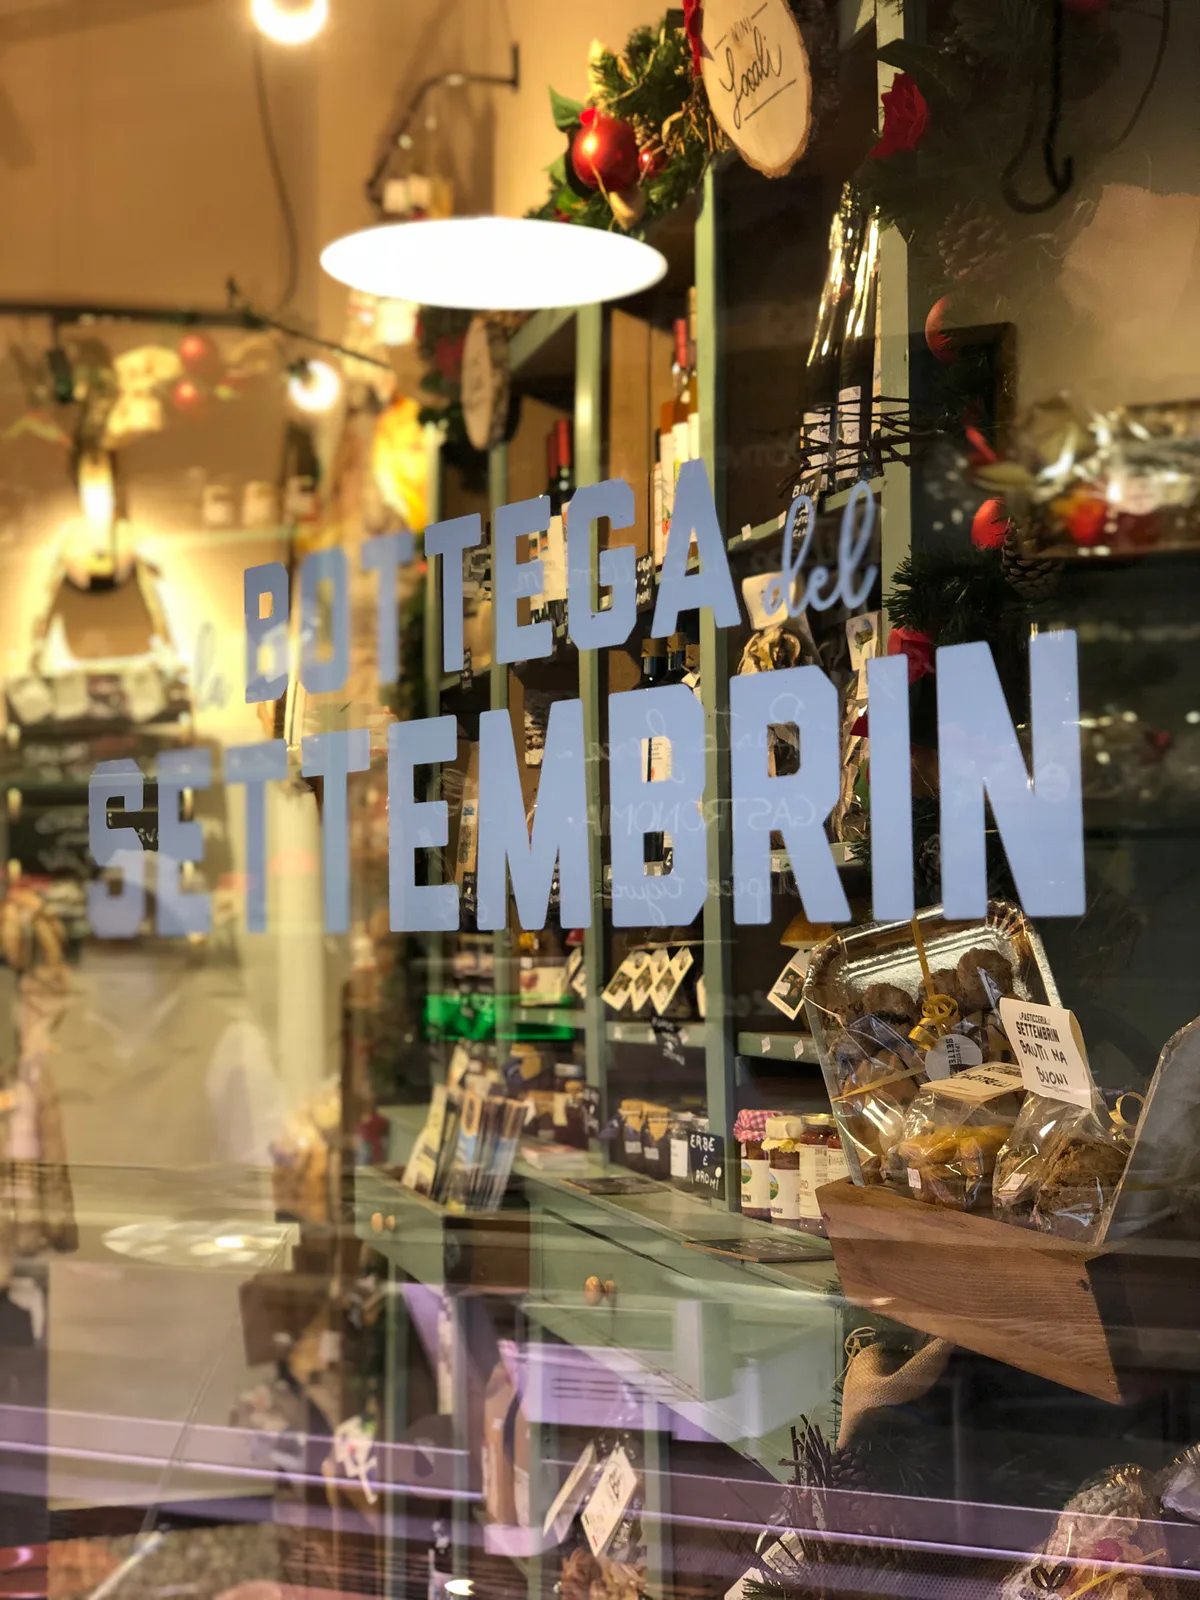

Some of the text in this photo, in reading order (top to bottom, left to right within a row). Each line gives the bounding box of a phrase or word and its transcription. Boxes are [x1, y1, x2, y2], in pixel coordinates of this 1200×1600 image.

[791, 479, 815, 499] BRUT
[243, 458, 741, 704] BOTTEGA
[763, 479, 878, 618] del
[87, 628, 1086, 938] SETTEMBRIN
[1016, 1021, 1060, 1043] SETTEMBRIN
[690, 1134, 716, 1152] ERBE
